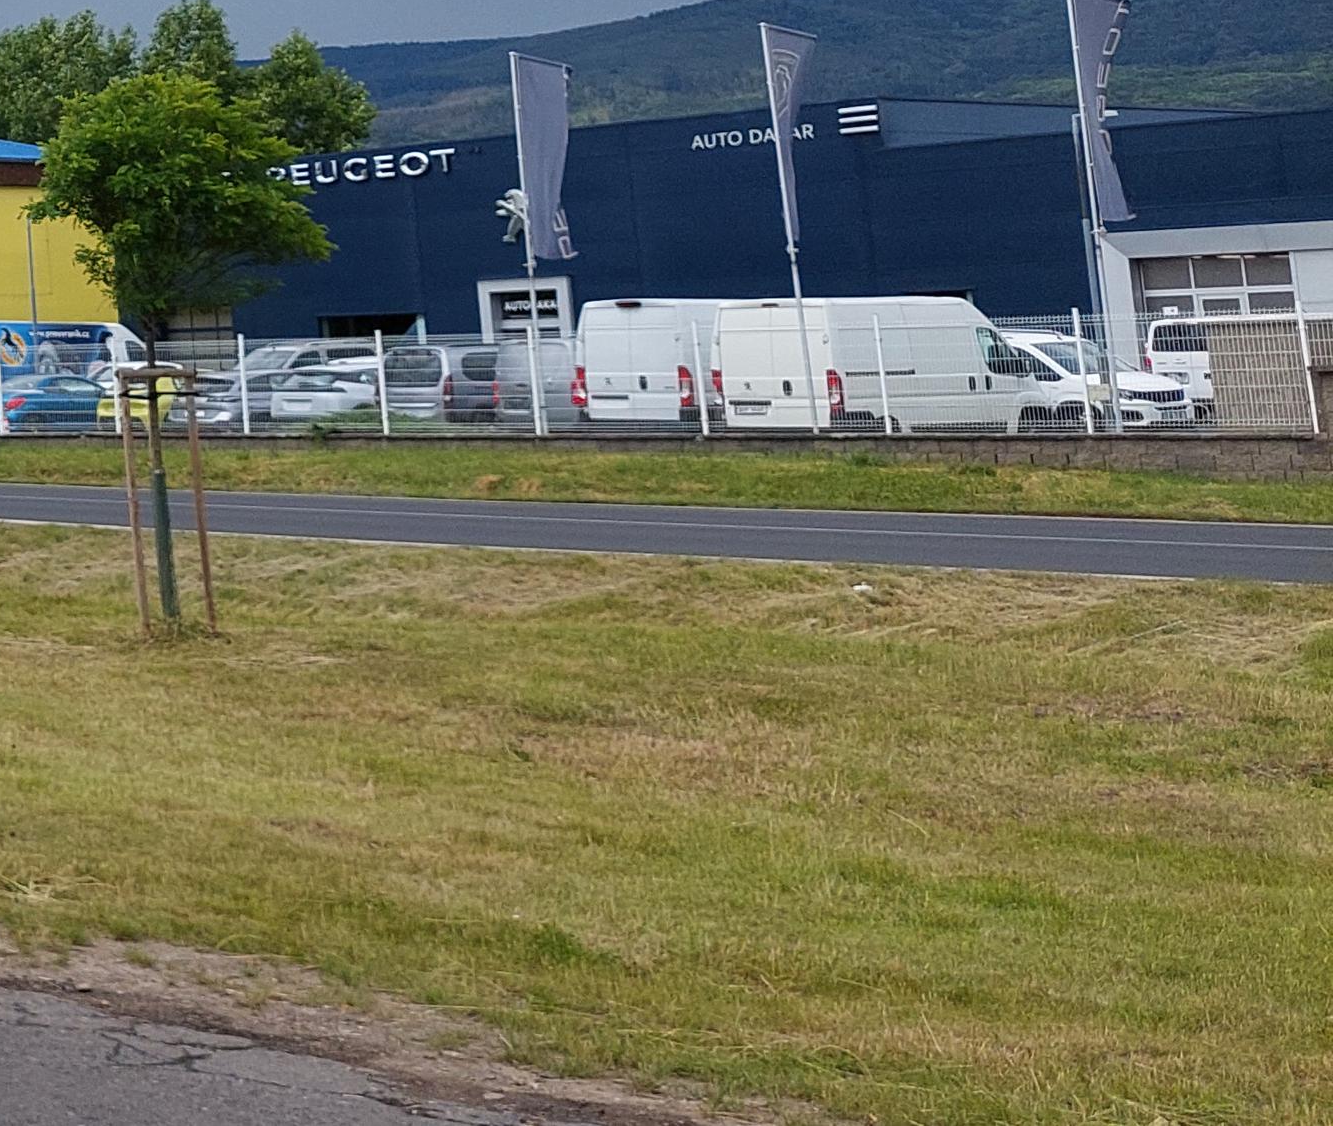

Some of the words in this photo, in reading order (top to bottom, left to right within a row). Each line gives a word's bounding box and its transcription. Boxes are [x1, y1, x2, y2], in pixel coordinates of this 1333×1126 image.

[691, 130, 743, 150] AUTO
[748, 124, 815, 144] DAAR
[266, 148, 456, 186] PEUGEOT
